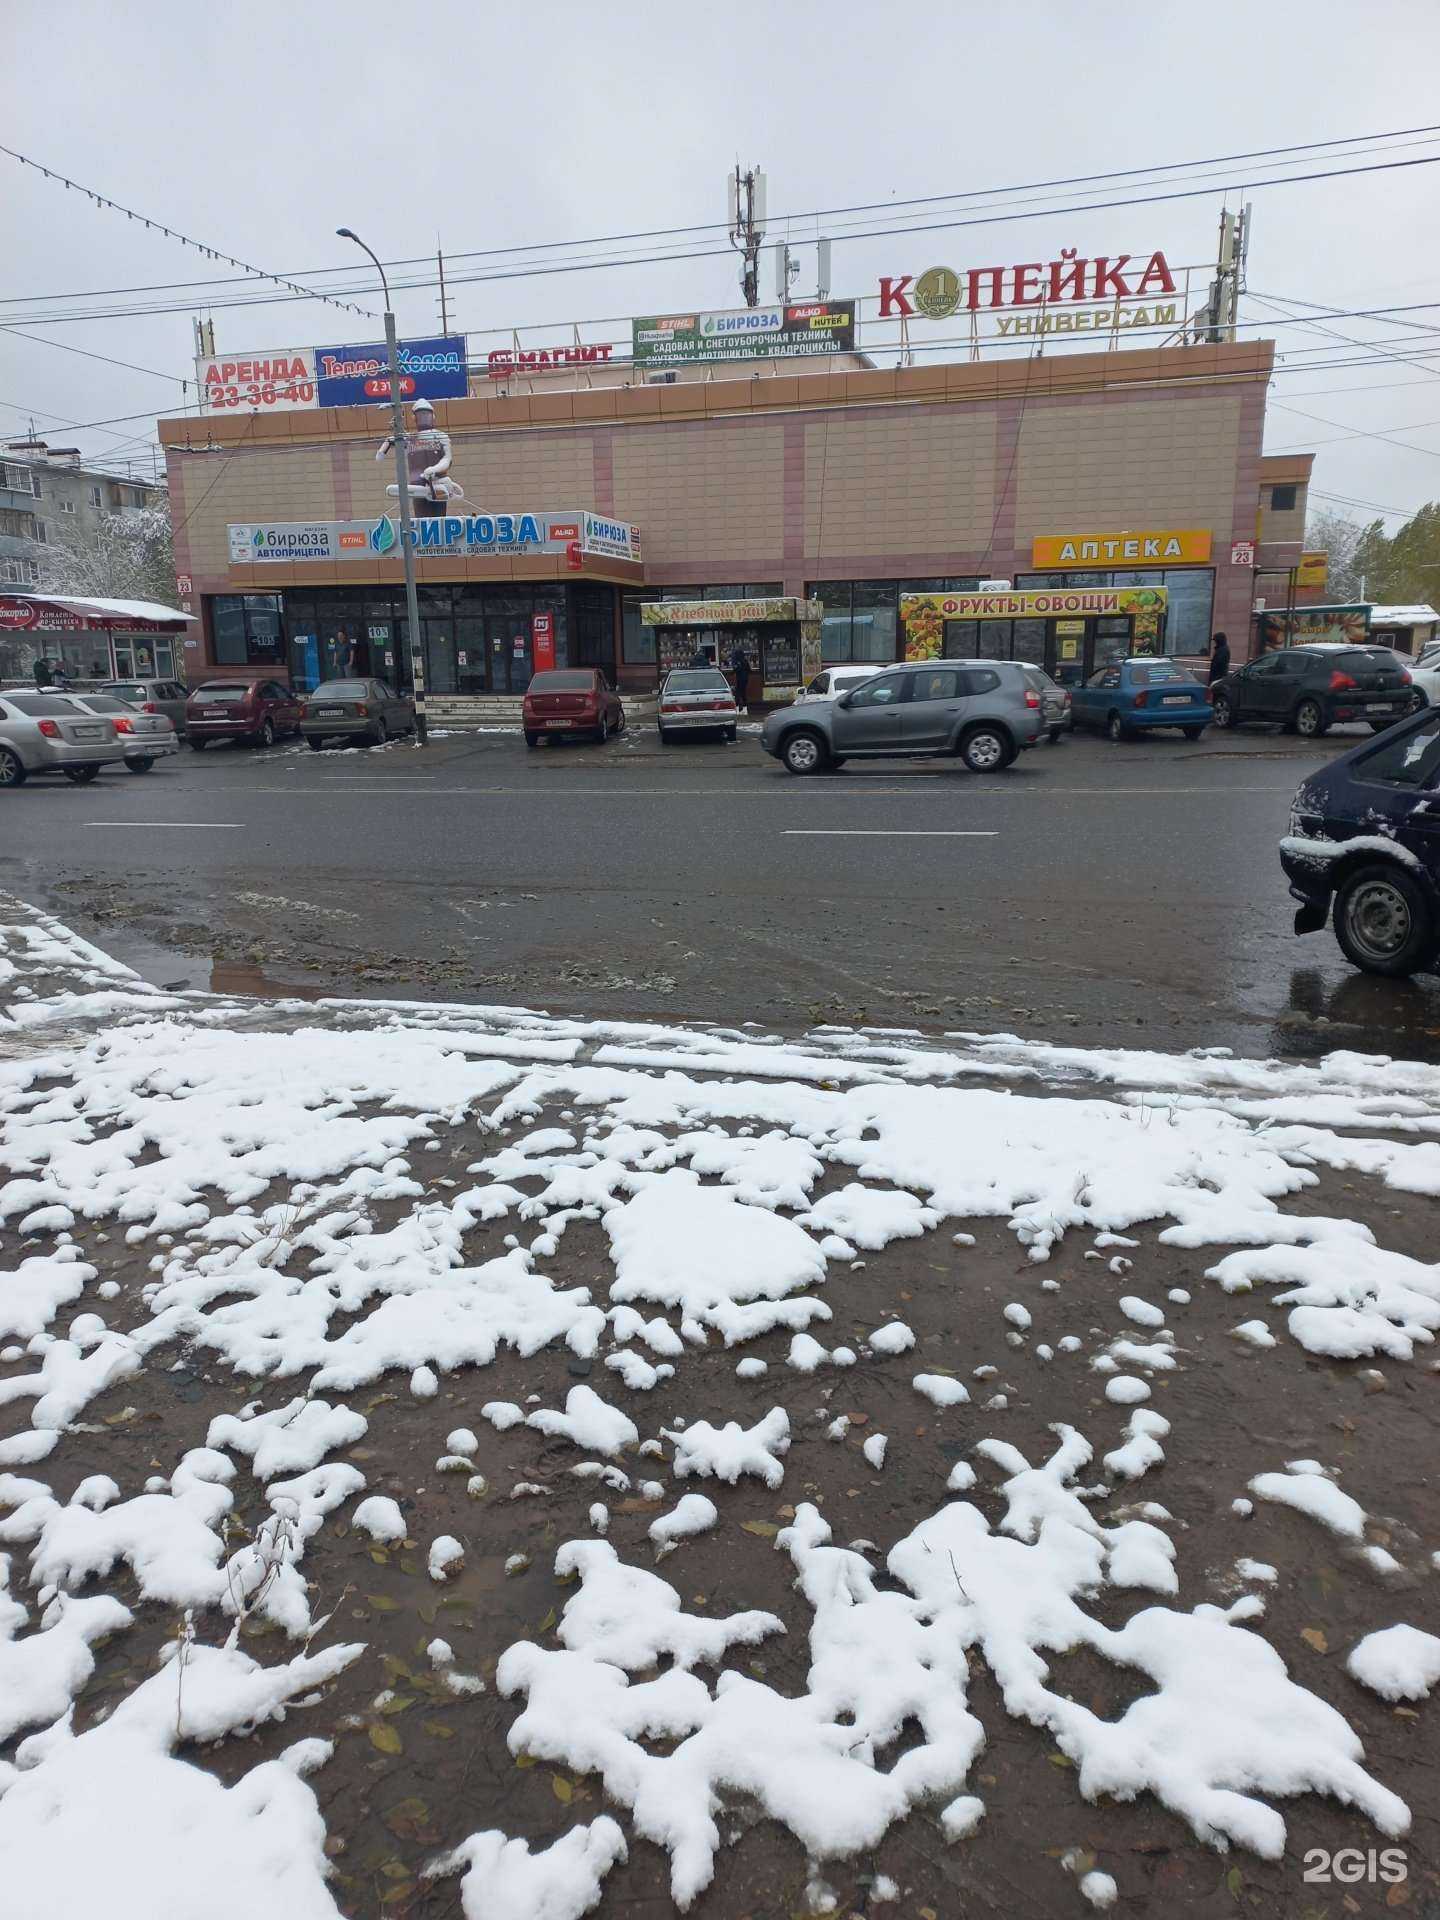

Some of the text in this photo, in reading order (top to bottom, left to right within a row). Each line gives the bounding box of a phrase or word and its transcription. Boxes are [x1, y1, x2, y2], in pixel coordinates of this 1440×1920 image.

[660, 319, 690, 330] STIHL
[716, 314, 779, 331] БИРЮЗА
[996, 303, 1176, 336] УНИВЕРСАМ
[653, 329, 833, 353] САДОВАЯ И СНЕГОУБОРОЧНАЯ ТЕХНИКА
[768, 340, 841, 356] КВАДРОЦИКЛЫ
[518, 345, 612, 372] МАГНИТ
[205, 357, 308, 384] АРЕНДА
[210, 383, 314, 408] 23-36-40
[267, 531, 329, 547] бирюза
[593, 520, 627, 543] БИРЮЗА
[257, 548, 330, 558] АВТОПРИЦЕПЫ
[1059, 538, 1183, 560] АПТЕКА
[1235, 552, 1249, 563] 23
[180, 582, 190, 592] 23
[942, 594, 1119, 615] ФРУКТЫ-ОВОЩИ
